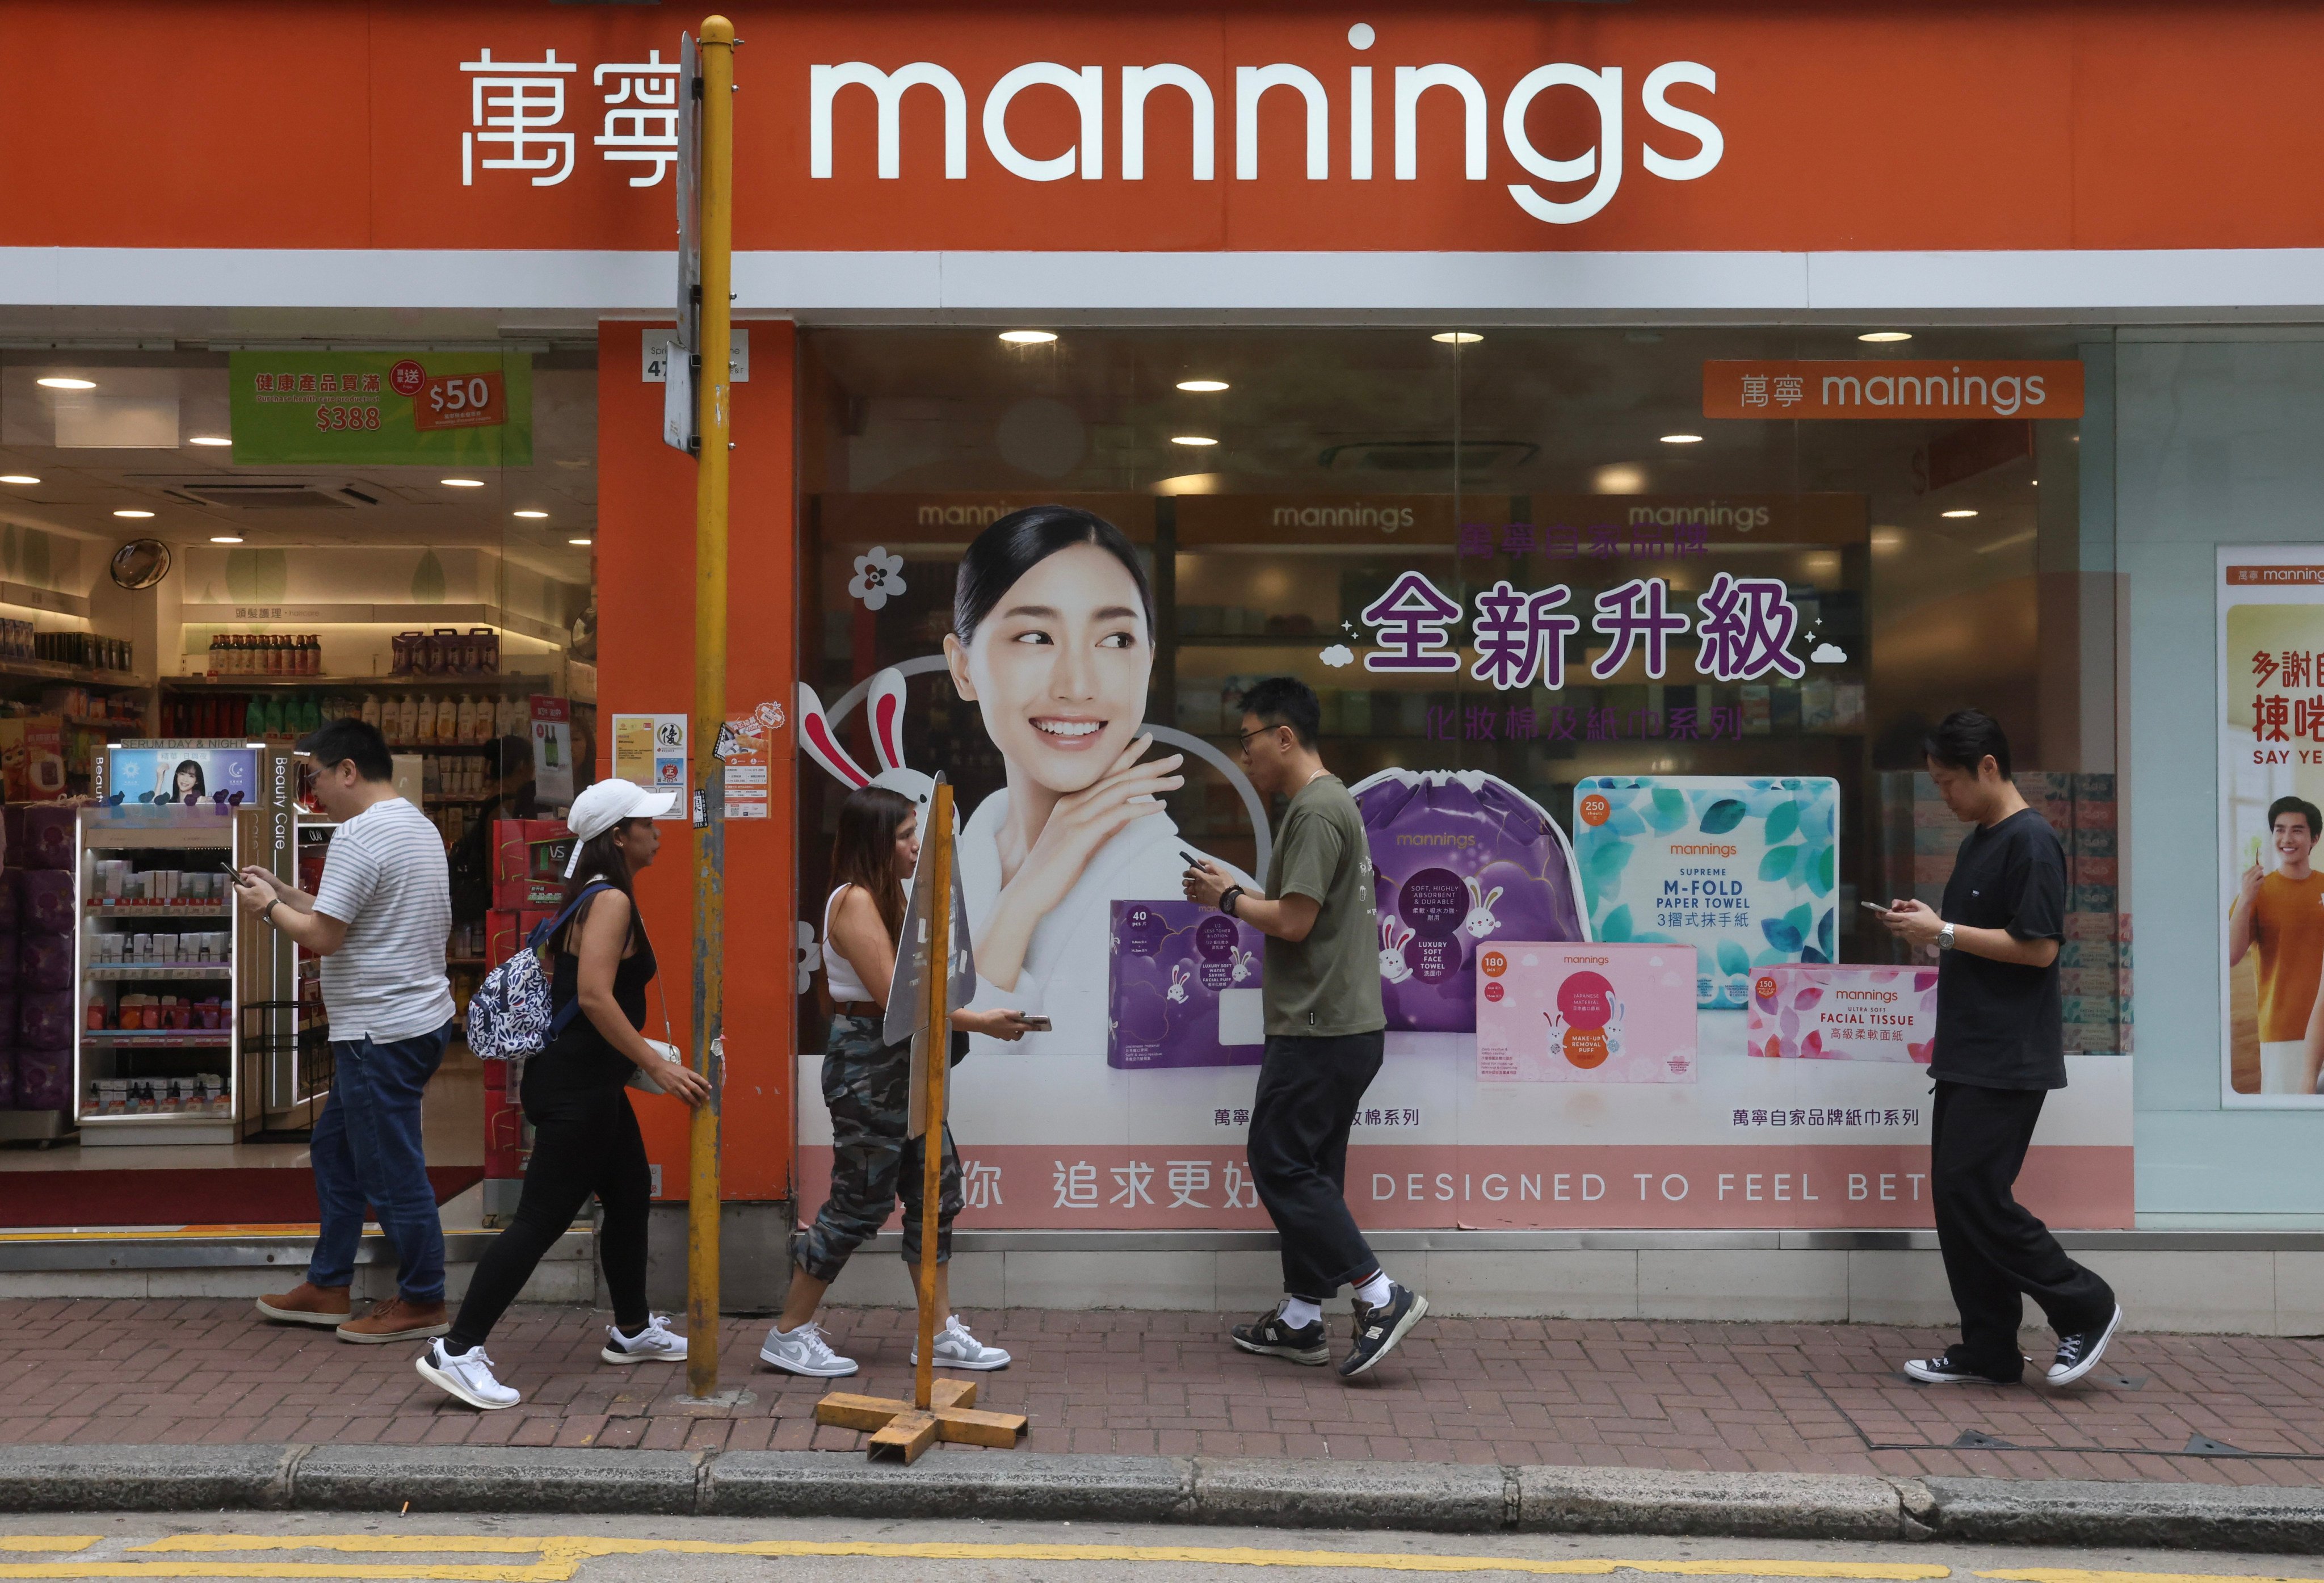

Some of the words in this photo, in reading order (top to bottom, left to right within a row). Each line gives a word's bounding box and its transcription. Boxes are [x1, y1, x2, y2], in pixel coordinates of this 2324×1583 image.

[459, 47, 680, 188] 萬寧
[810, 23, 1724, 224] mannings
[651, 347, 667, 355] Spri
[255, 373, 380, 392] 健康產品買滿
[405, 369, 419, 383] 送
[430, 378, 488, 412] $50
[1741, 373, 1804, 408] 萬寧
[1822, 367, 2046, 415] mannings
[316, 405, 381, 432] $388
[918, 500, 1016, 525] manni
[1274, 503, 1414, 534] mannings
[1629, 501, 1769, 531] mannings
[1457, 522, 1710, 561] 萬寧自家品牌
[2238, 570, 2258, 581] 萬寧
[2264, 568, 2324, 582] manning
[236, 607, 281, 619] 頭髮護理
[1361, 570, 1805, 691] 全新升級
[122, 739, 165, 749] SERUM
[168, 739, 192, 749] DAY
[196, 739, 205, 749] &
[209, 739, 245, 749] NIGHT
[2254, 750, 2290, 764] SAY
[2299, 750, 2323, 764] YE
[95, 757, 104, 804] Beaut
[274, 757, 289, 808] Beauty
[1585, 802, 1604, 811] 250
[275, 813, 288, 850] Care
[309, 830, 323, 842] OLAY
[1397, 833, 1475, 849] mannings
[550, 846, 565, 858] VS
[1670, 843, 1737, 858] mannings
[1664, 880, 1743, 896] M-FOLD
[1657, 898, 1699, 908] PAPER
[1705, 898, 1750, 908] TOWEL
[1657, 912, 1749, 927] 3摺式抹手紙
[1485, 958, 1503, 967] 180
[1564, 955, 1609, 965] mannings
[1836, 989, 1898, 1003] mannings
[1821, 1013, 1864, 1024] FACIAL
[1870, 1015, 1914, 1025] TISSUE
[1831, 1028, 1903, 1041] 高級柔軟面紙
[1214, 1108, 1249, 1126] 萬寧
[1733, 1108, 1919, 1127] 萬寧自家品牌紙巾系列
[1053, 1160, 1259, 1208] 追求更好
[1372, 1173, 1606, 1200] DESIGNED
[1634, 1174, 1689, 1201] TO
[1718, 1174, 1818, 1201] FEEL
[1849, 1174, 1925, 1201] BET
[1265, 1328, 1278, 1341] N
[1365, 1325, 1384, 1340] N
